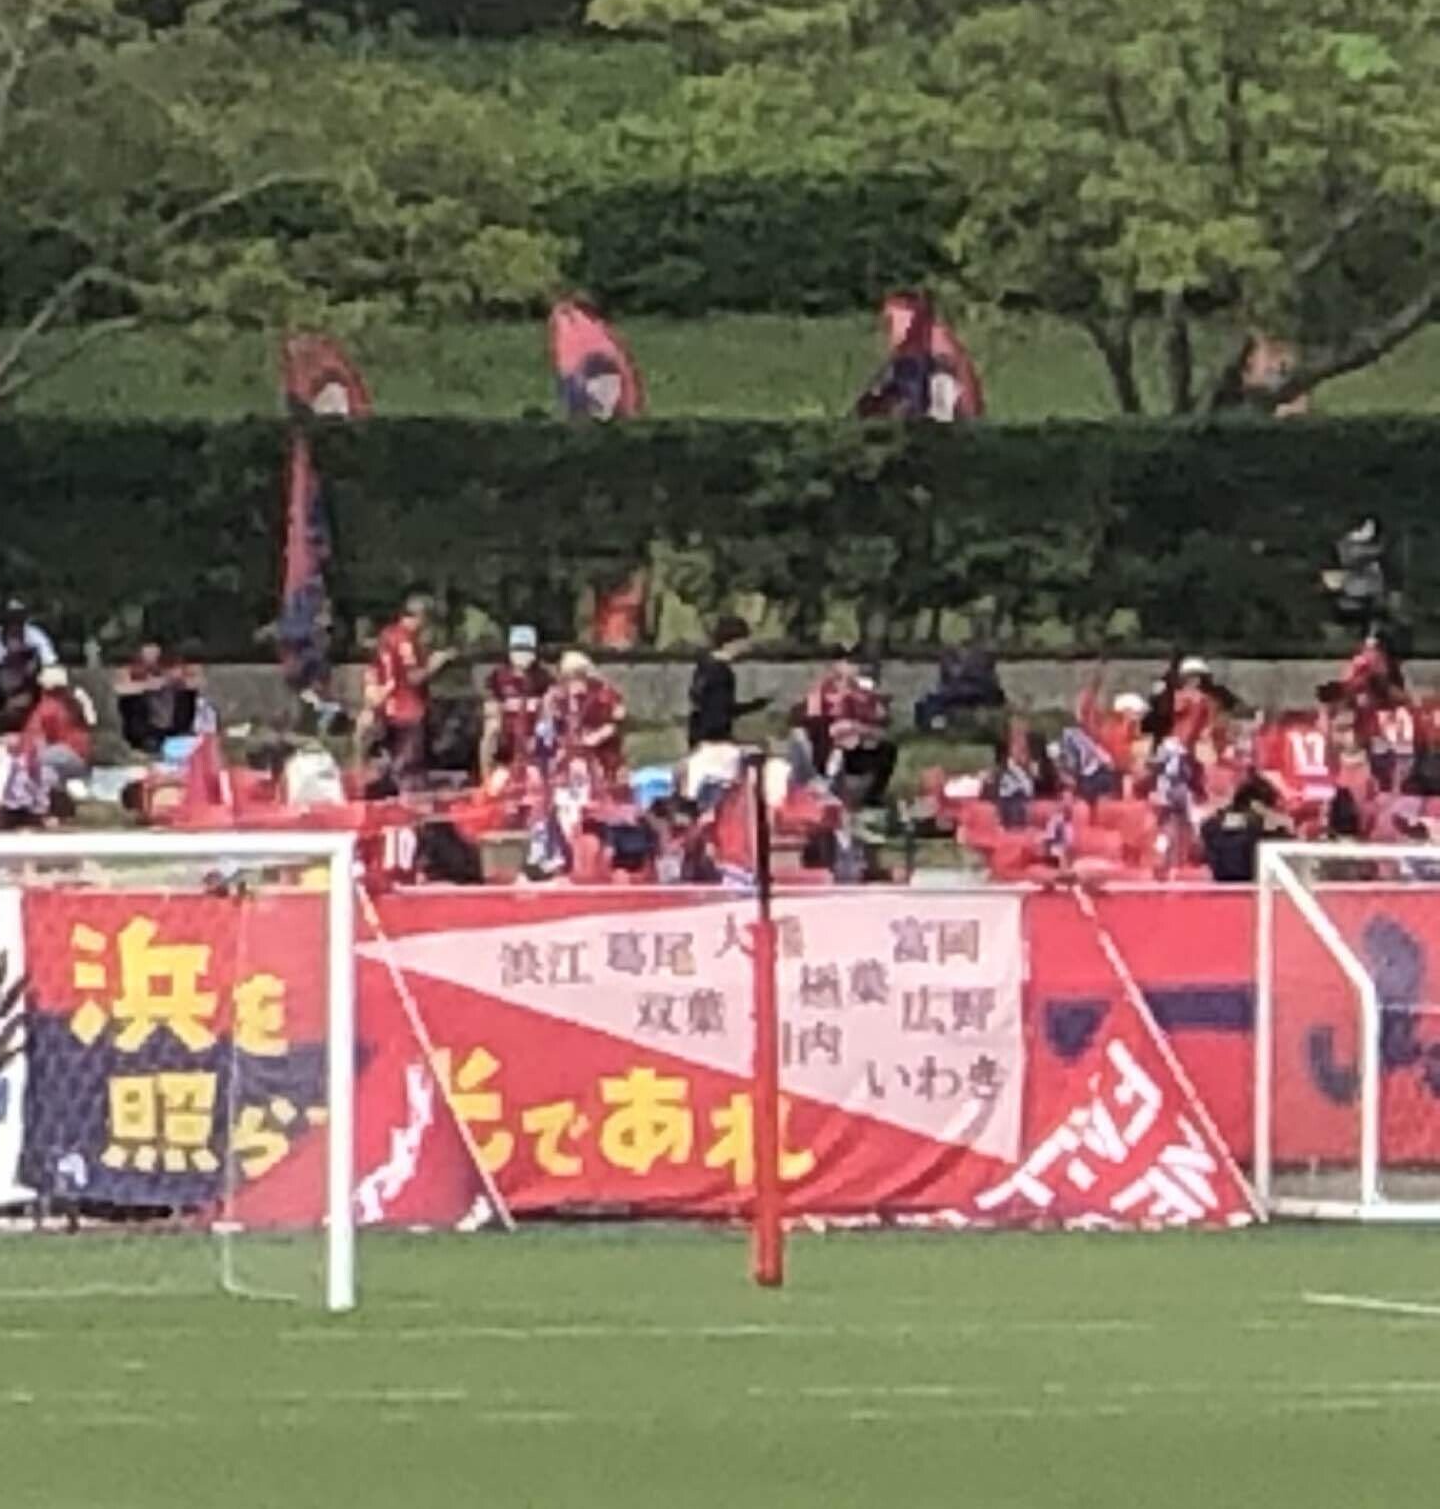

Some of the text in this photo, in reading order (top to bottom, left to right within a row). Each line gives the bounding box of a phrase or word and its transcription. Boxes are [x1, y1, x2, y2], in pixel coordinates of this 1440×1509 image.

[68, 916, 288, 1054] 浜を
[866, 1054, 1008, 1106] いわき
